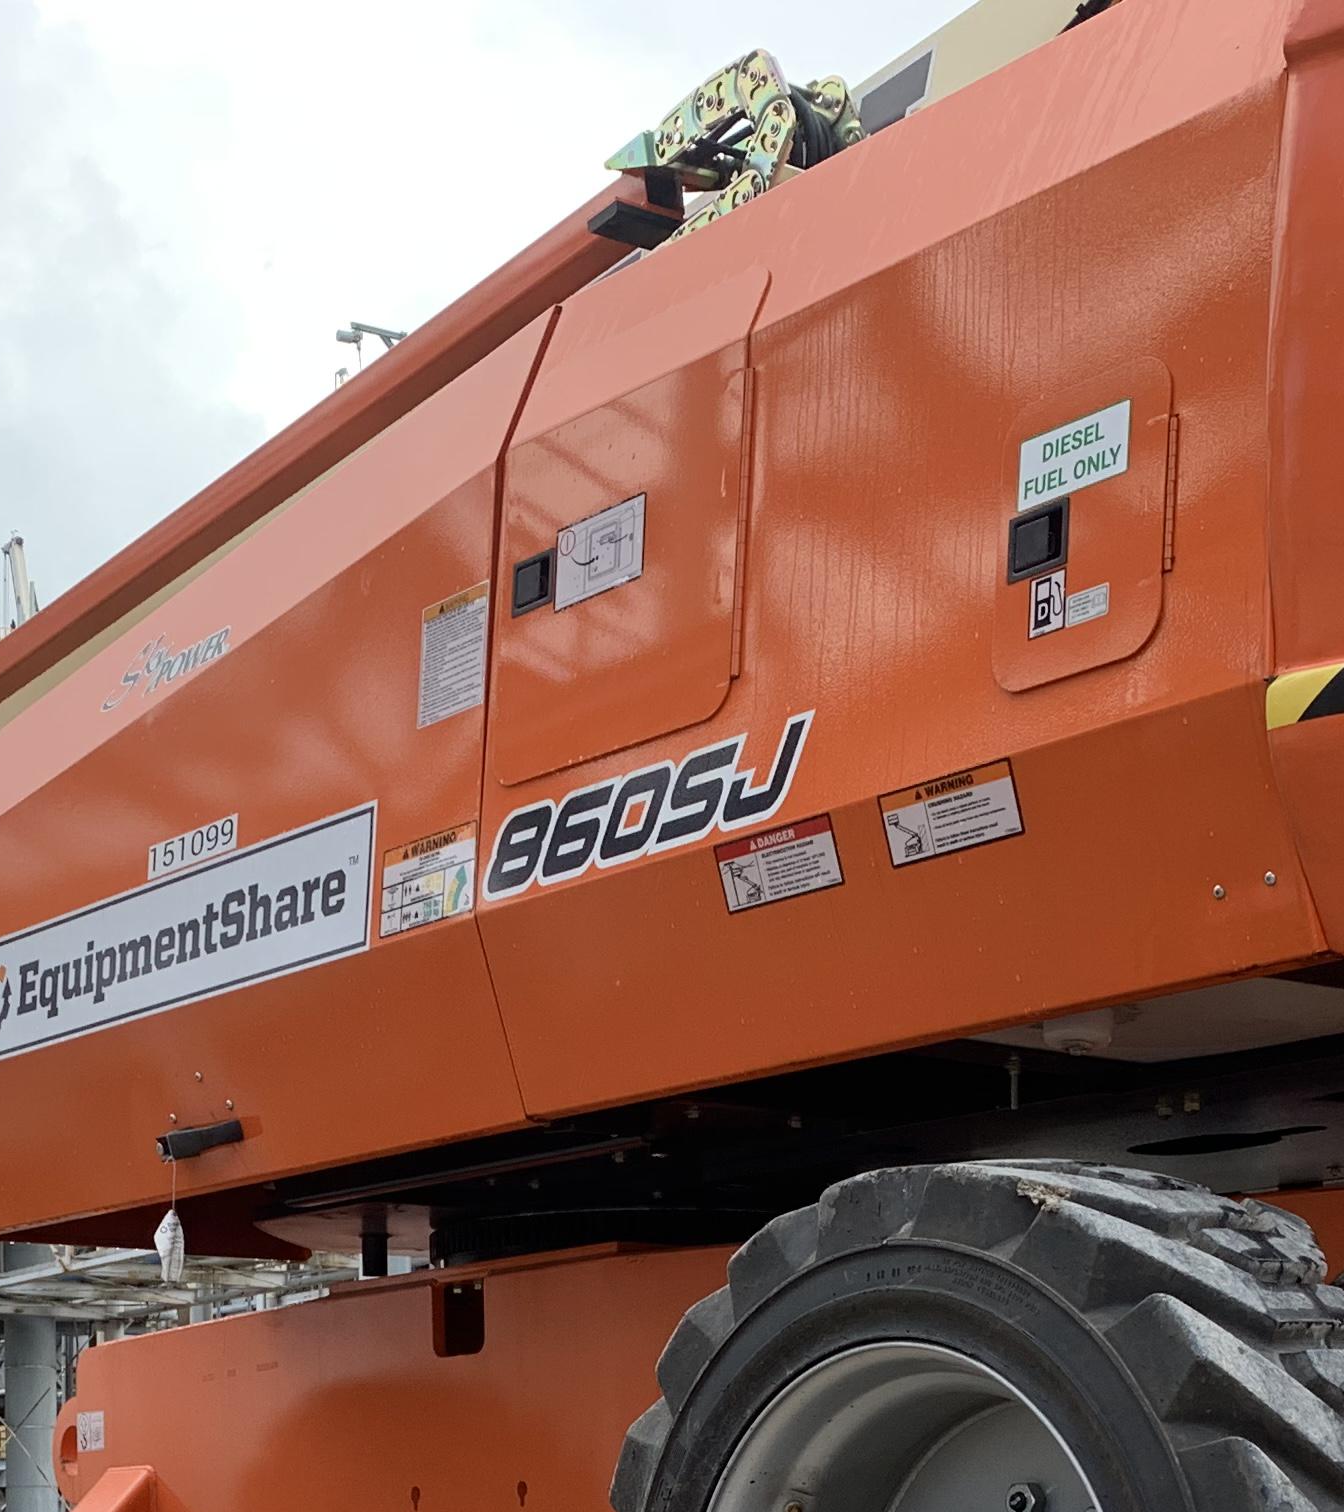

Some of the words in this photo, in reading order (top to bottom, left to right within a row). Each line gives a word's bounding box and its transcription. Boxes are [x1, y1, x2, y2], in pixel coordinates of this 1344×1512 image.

[1042, 421, 1105, 463] DIESEL
[1023, 467, 1068, 500] FUEL
[1073, 443, 1122, 480] ONLY
[485, 714, 812, 898] 860SJ
[924, 774, 974, 798] WARNING
[150, 821, 235, 872] 151099
[757, 828, 796, 847] DANGER
[17, 866, 347, 1019] EquipmentShare
